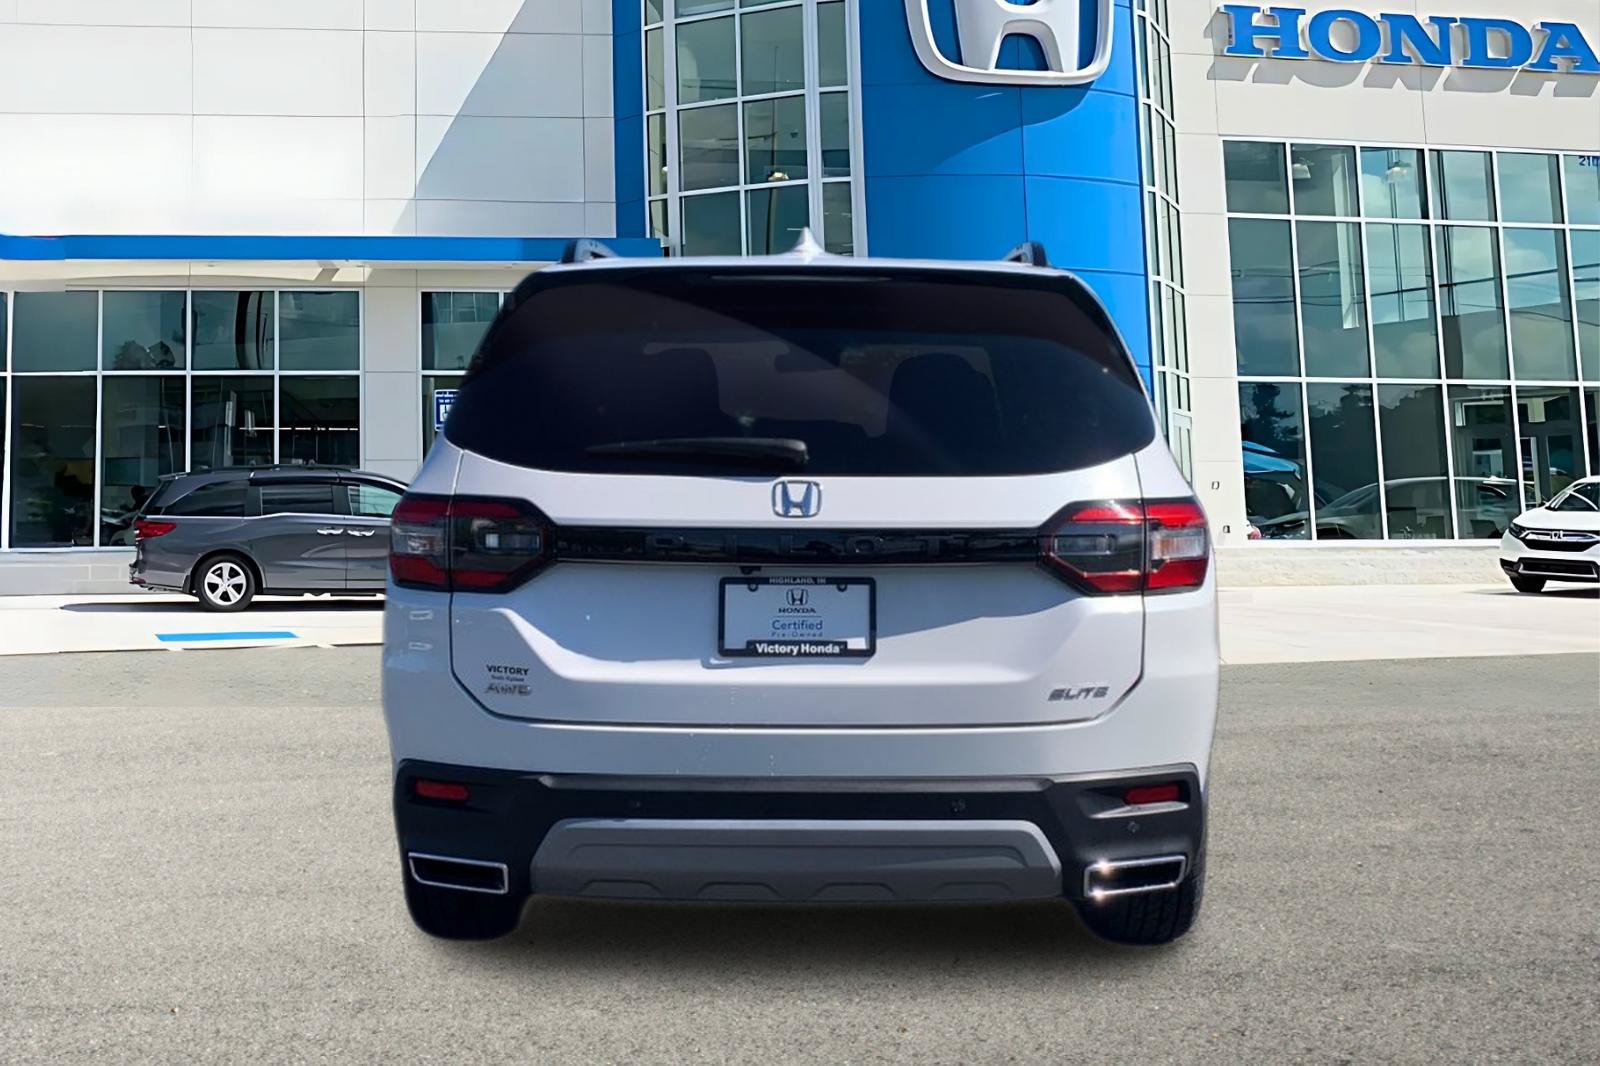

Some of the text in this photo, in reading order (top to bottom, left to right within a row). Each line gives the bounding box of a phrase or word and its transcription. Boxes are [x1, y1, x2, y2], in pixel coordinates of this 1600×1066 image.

[1223, 4, 1600, 72] HONDA
[772, 619, 823, 630] Certified
[756, 642, 840, 655] Victory Honda
[486, 664, 529, 675] VICTORY
[1048, 686, 1109, 701] ELITE
